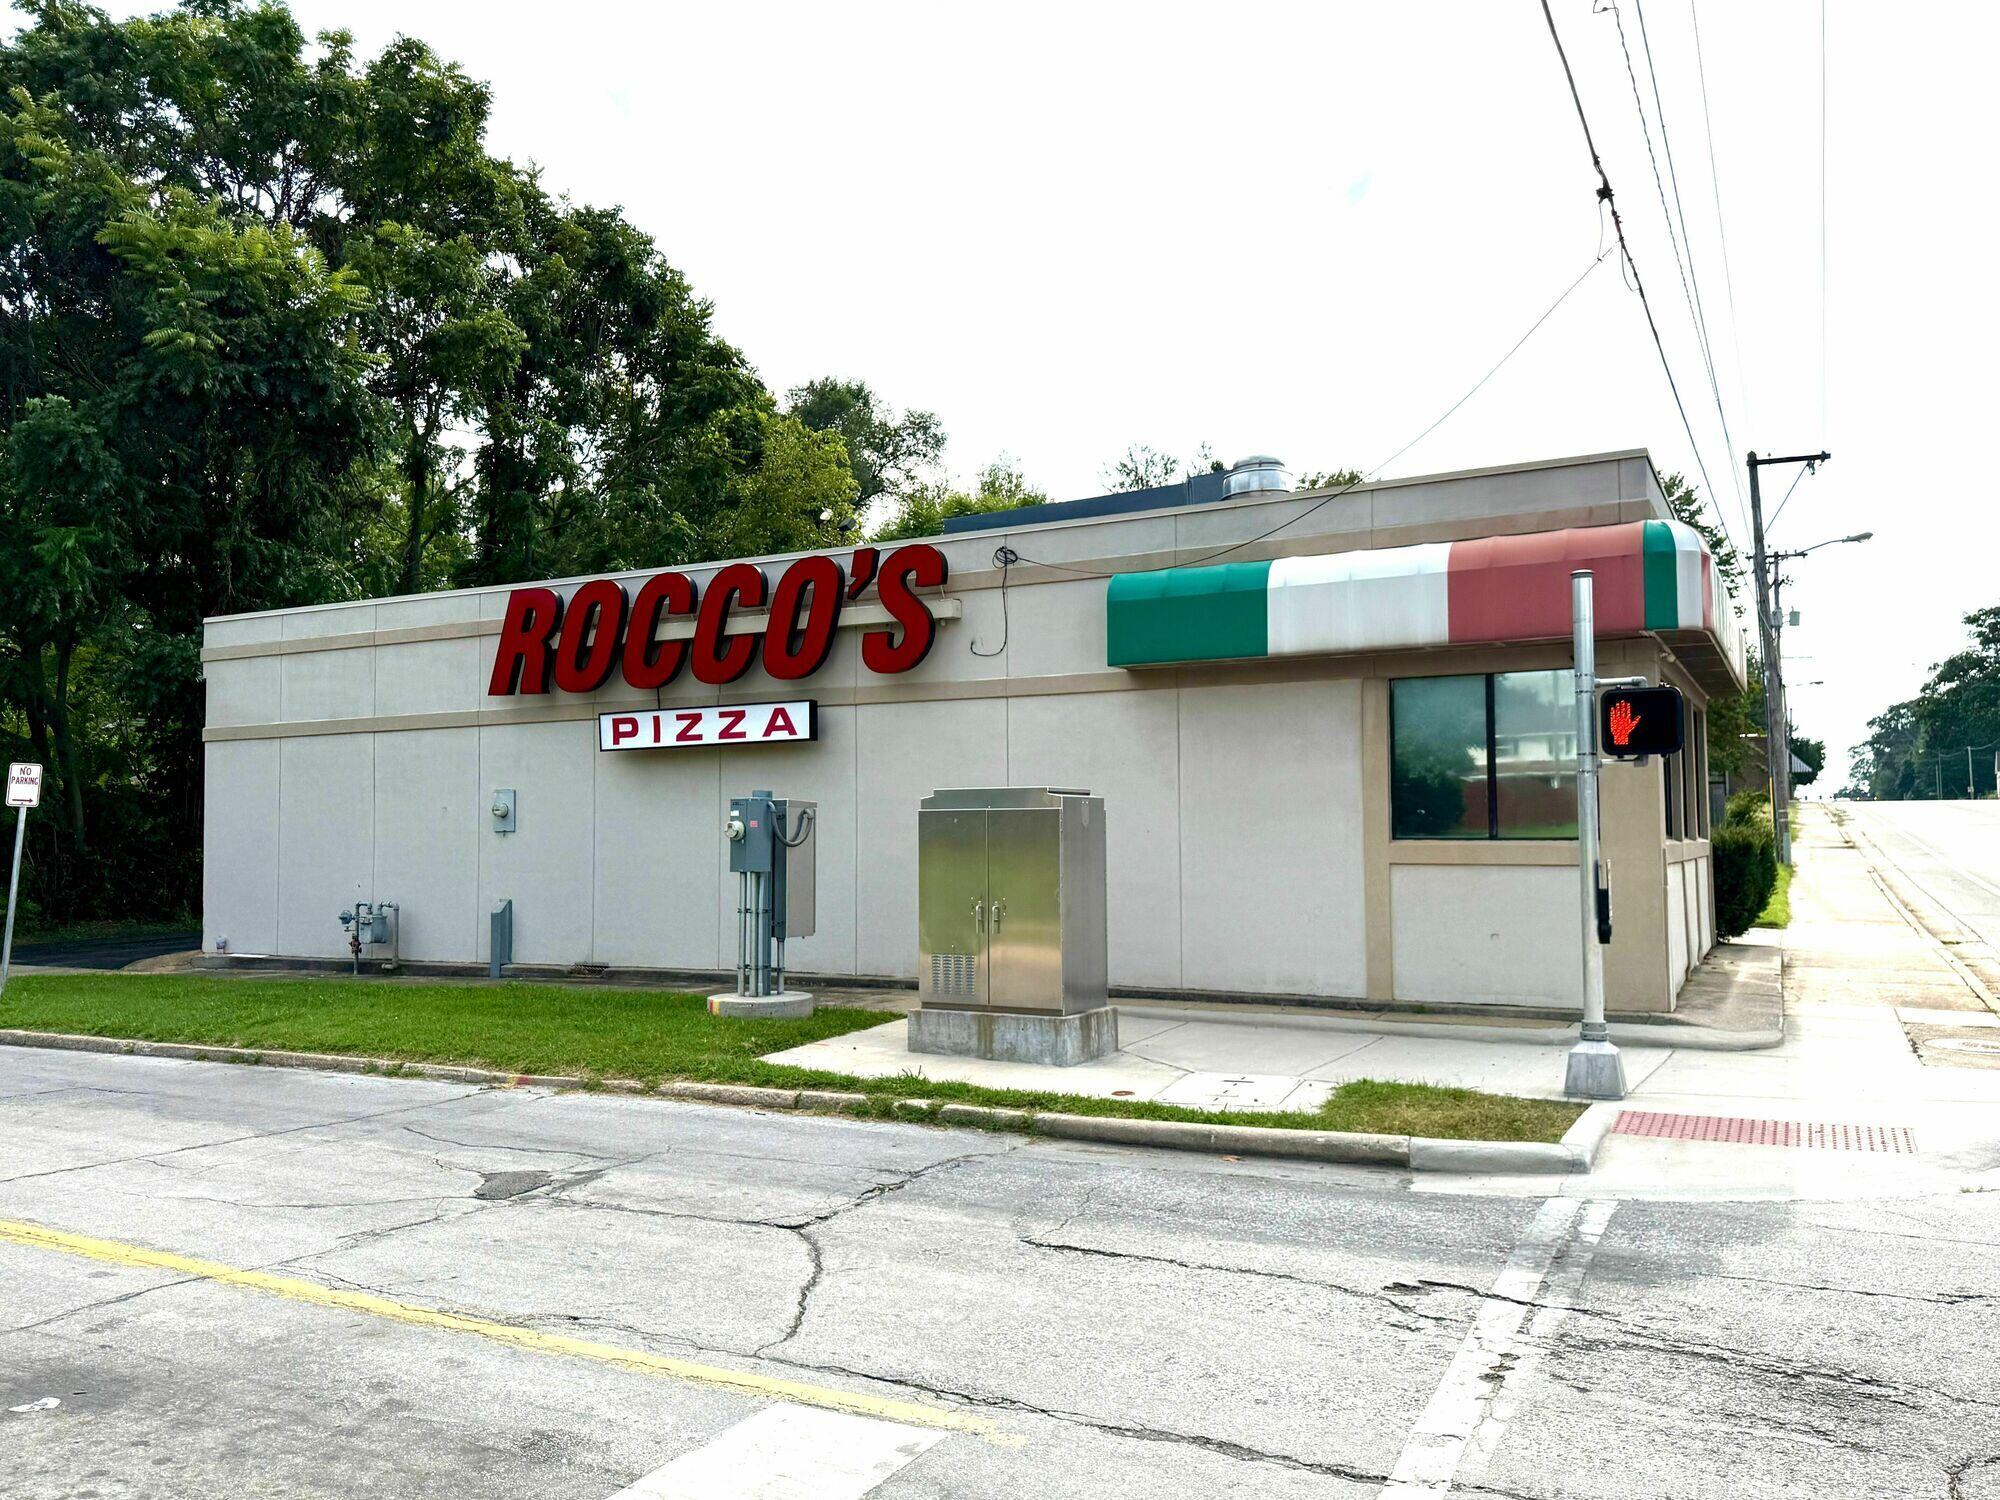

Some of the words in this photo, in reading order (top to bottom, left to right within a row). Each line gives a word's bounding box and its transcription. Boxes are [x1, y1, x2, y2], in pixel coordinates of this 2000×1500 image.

[488, 544, 949, 696] ROCCO'S
[611, 706, 798, 745] PIZZA
[10, 776, 39, 785] PARKING
[19, 767, 32, 775] NO
